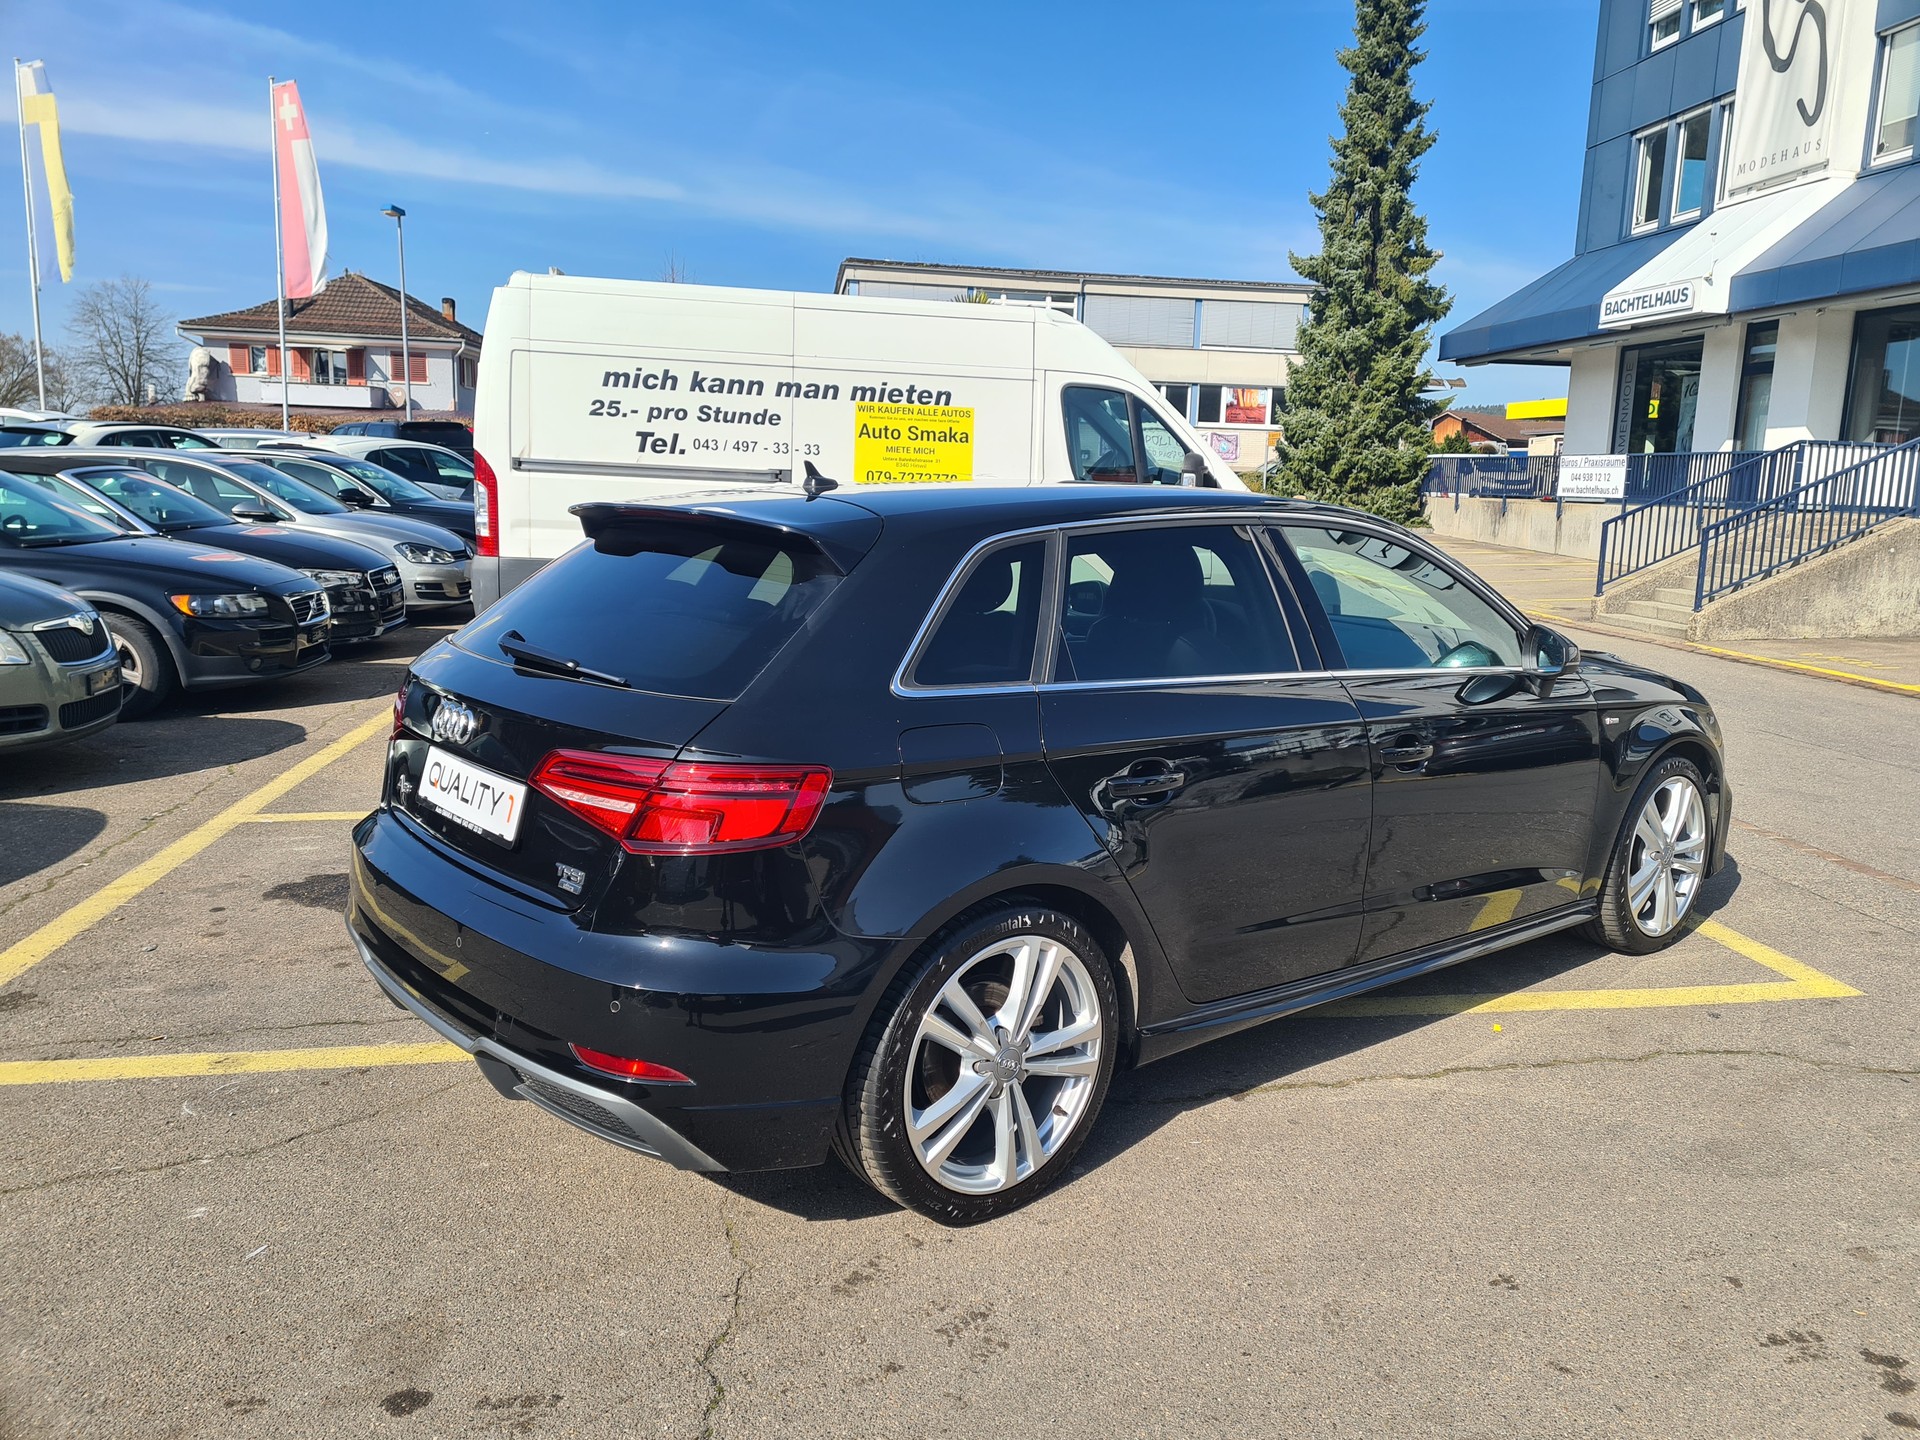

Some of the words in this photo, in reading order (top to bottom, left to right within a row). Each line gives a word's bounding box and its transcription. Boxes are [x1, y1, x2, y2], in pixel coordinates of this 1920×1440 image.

[1737, 138, 1822, 176] MODEHAUS
[1604, 286, 1689, 317] BACHTELHAUS
[602, 367, 678, 392] mich
[689, 370, 764, 396] kann
[775, 379, 839, 400] man
[850, 382, 952, 406] mieten
[589, 400, 639, 418] 25.-
[646, 406, 688, 423] pro
[697, 405, 782, 427] Stunde
[858, 404, 875, 414] WIR
[877, 406, 914, 416] KAUFEN
[917, 408, 938, 417] ALLE
[941, 409, 971, 418] AUTOS
[858, 423, 901, 440] Auto
[907, 425, 969, 443] Smaka
[634, 431, 686, 455] Tel.
[692, 438, 719, 451] 043
[732, 440, 759, 453] 497
[773, 442, 790, 455] 33
[804, 443, 821, 456] 33
[886, 446, 911, 454] MIETE
[913, 447, 935, 455] MICH
[1561, 457, 1578, 467] Büros
[1584, 456, 1625, 467] Praxisräume
[1571, 473, 1581, 481] 044
[1583, 473, 1593, 481] 938
[1595, 473, 1602, 481] 12
[1604, 473, 1611, 481] 12
[1561, 485, 1619, 495] www.bachtelhaus.ch
